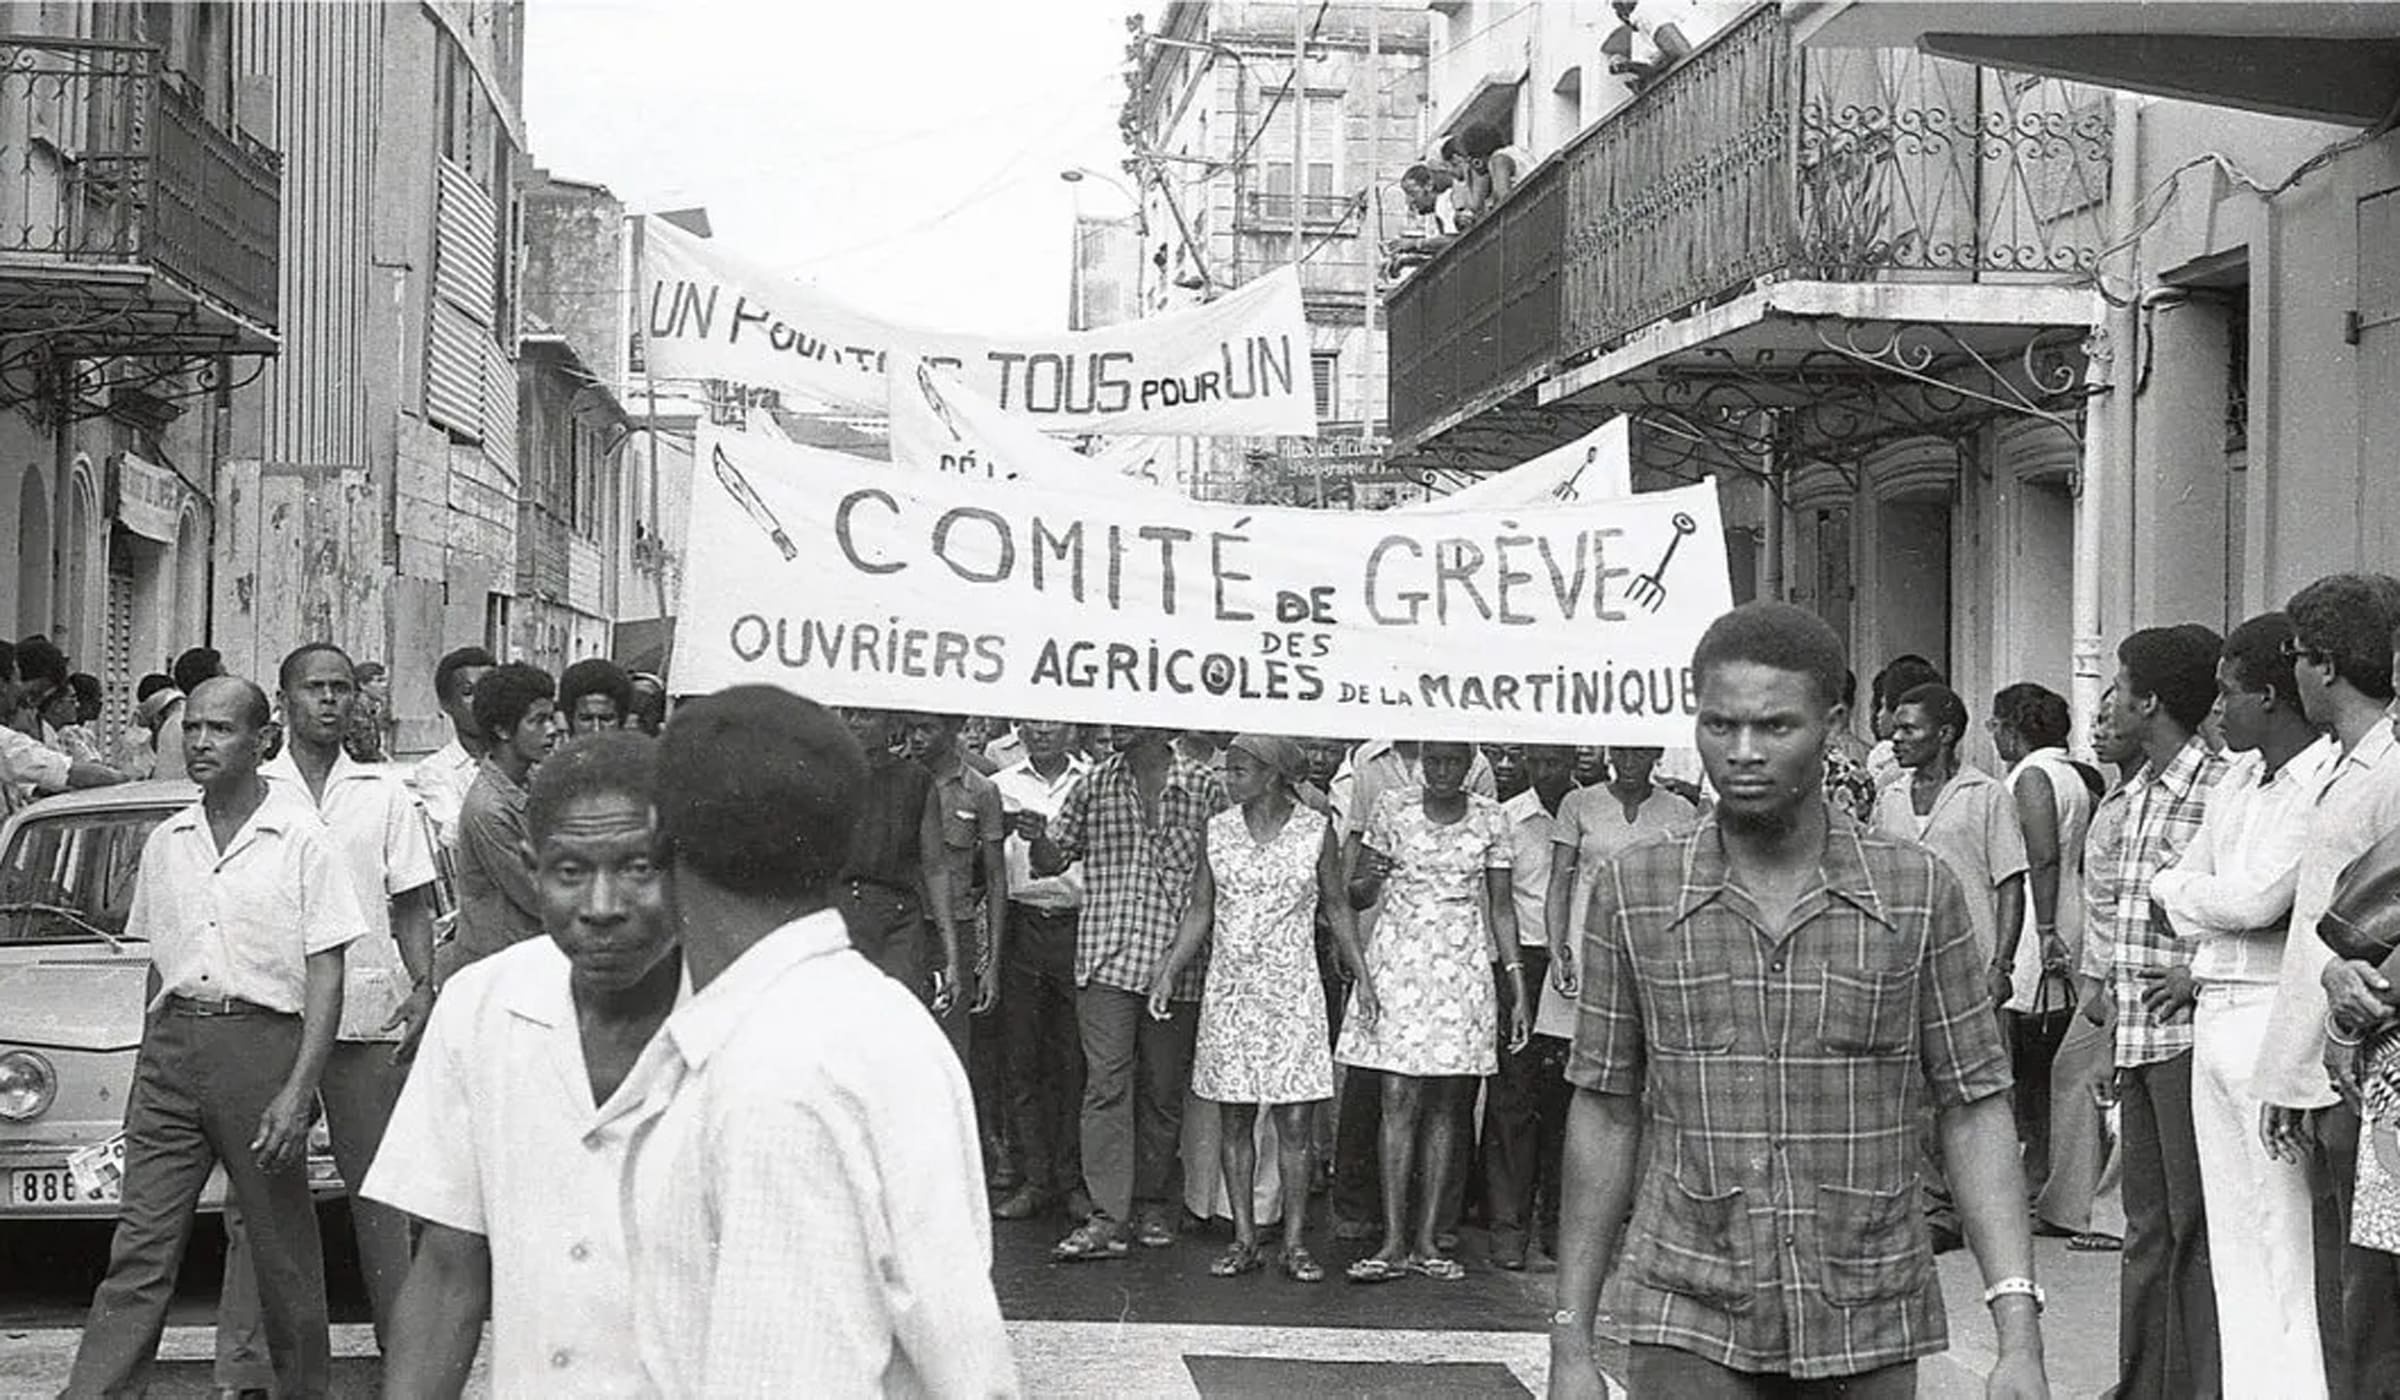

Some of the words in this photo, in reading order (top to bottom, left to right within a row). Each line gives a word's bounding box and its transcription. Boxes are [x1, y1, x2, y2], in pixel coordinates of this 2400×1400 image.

[651, 280, 719, 339] UN
[987, 351, 1134, 415] TOUS
[1140, 371, 1222, 411] POUR
[1221, 334, 1293, 400] UN
[834, 488, 1255, 621] COMITÉ
[1274, 585, 1337, 625] DE
[1364, 520, 1632, 626] GRÈVE
[1259, 630, 1332, 658] DES
[1337, 681, 1371, 705] DE
[1380, 683, 1413, 708] LA
